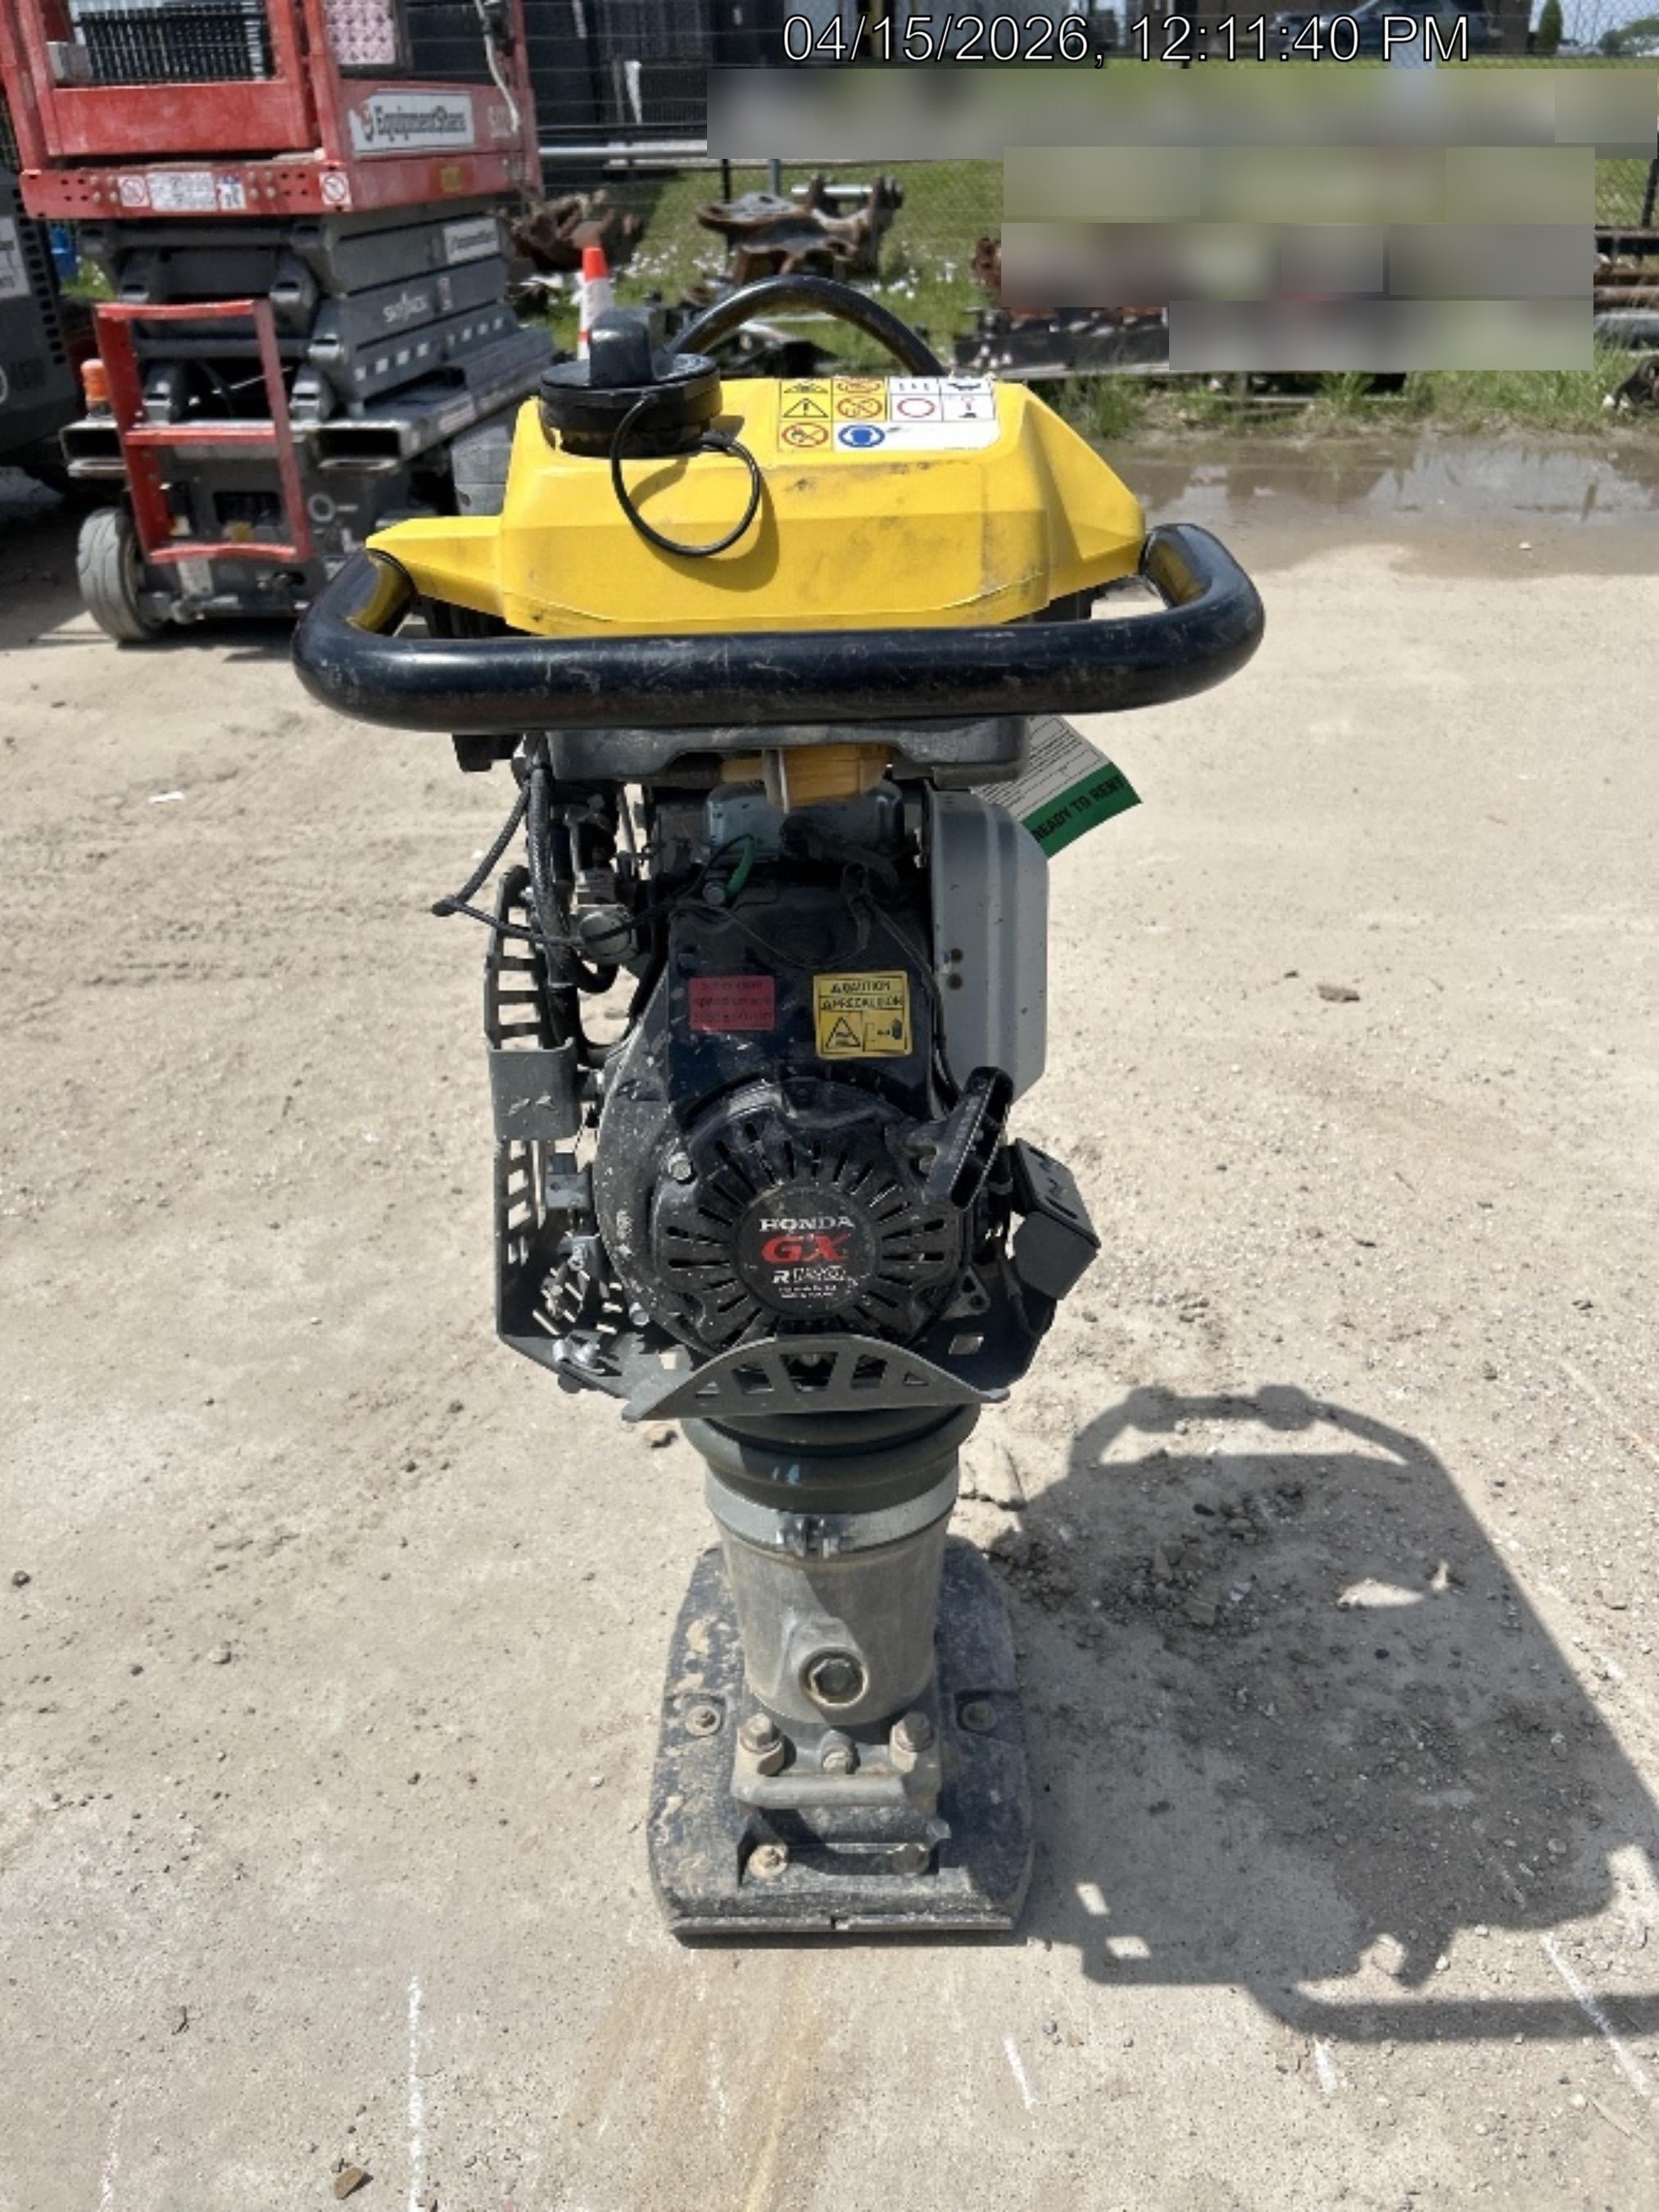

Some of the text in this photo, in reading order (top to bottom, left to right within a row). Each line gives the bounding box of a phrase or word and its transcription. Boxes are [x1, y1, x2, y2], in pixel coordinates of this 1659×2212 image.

[1070, 795, 1092, 813] TO
[1088, 775, 1126, 800] RENT
[759, 1216, 855, 1232] HONDA
[761, 1232, 850, 1264] GX
